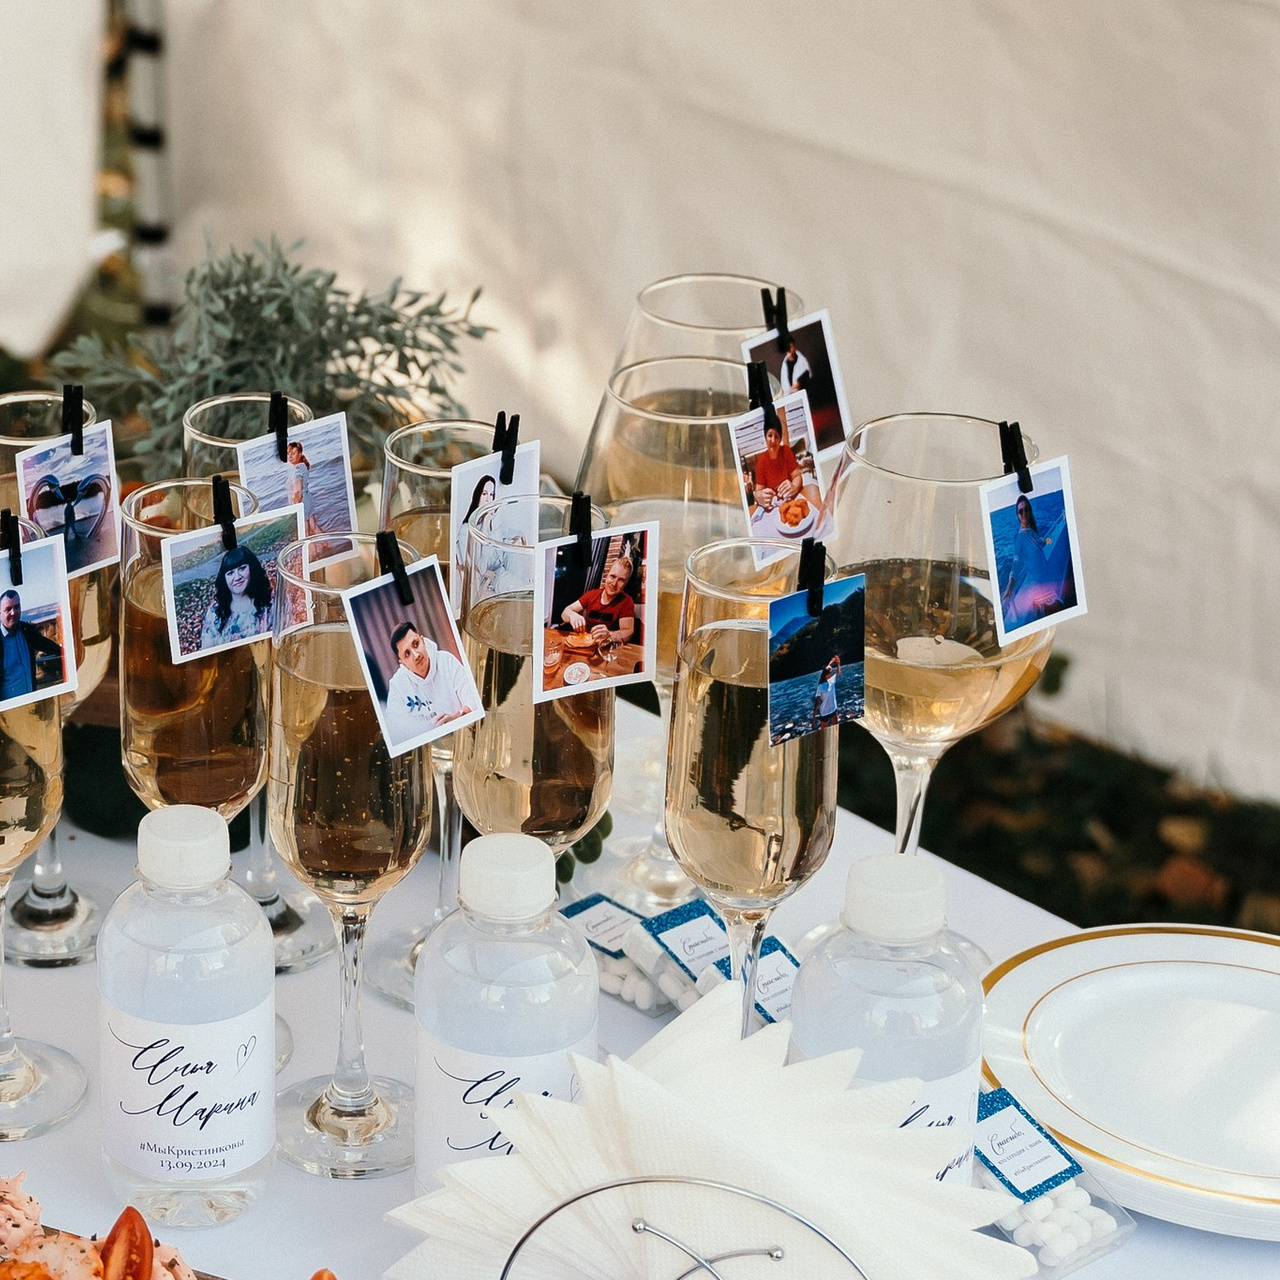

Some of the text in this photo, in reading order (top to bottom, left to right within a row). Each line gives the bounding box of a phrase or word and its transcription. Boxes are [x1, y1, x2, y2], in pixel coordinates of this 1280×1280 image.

[108, 1022, 218, 1085] Илья
[120, 1084, 260, 1131] Марина
[139, 1139, 245, 1159] #МыКристинковы
[159, 1157, 227, 1173] 13.09.2024
